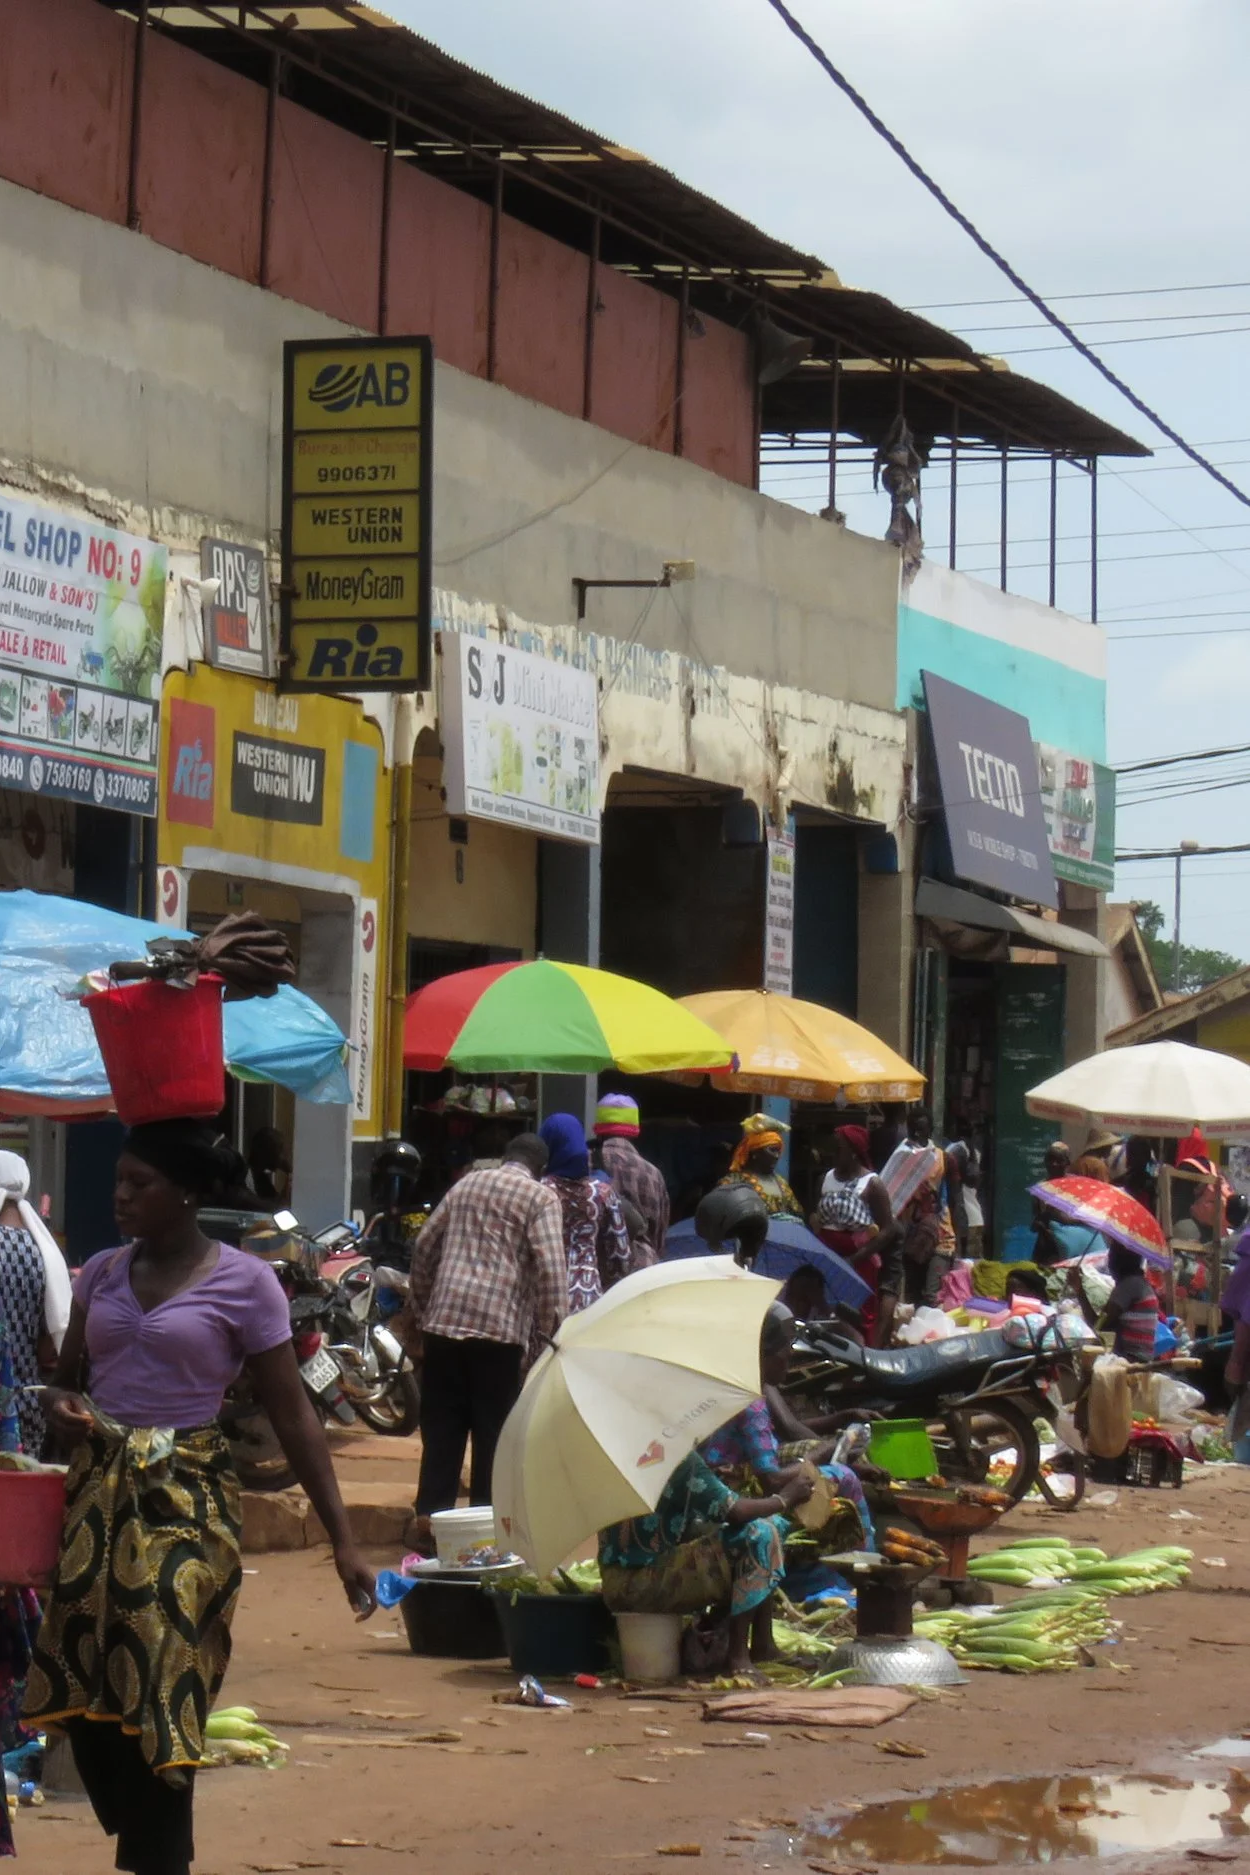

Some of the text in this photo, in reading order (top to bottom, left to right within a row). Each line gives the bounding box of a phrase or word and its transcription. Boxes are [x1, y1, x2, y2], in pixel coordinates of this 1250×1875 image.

[355, 361, 411, 408] AB
[317, 465, 396, 482] 9906371
[311, 507, 403, 525] WESTERN
[347, 526, 403, 544] UNION
[24, 517, 82, 569] SHOP
[129, 548, 142, 586] 9
[2, 568, 48, 599] JALLOW
[49, 585, 57, 601] &
[60, 586, 100, 615] SON'S)
[212, 545, 247, 614] APS
[306, 567, 405, 606] MoneyGram
[13, 602, 53, 628] Motorcycle
[53, 613, 75, 634] Spare
[75, 618, 95, 636] Parts
[22, 638, 29, 656] &
[32, 638, 68, 666] RETAIL
[307, 624, 404, 678] Ria
[467, 646, 483, 699] S
[494, 654, 506, 705] J
[173, 738, 213, 800] Ria
[237, 741, 290, 775] WESTERN
[292, 755, 317, 803] WU
[958, 741, 1025, 818] TECNO
[46, 761, 92, 792] 7586169
[106, 773, 150, 803] 3370805
[253, 771, 289, 798] UNION
[356, 972, 370, 1113] MoneyGram
